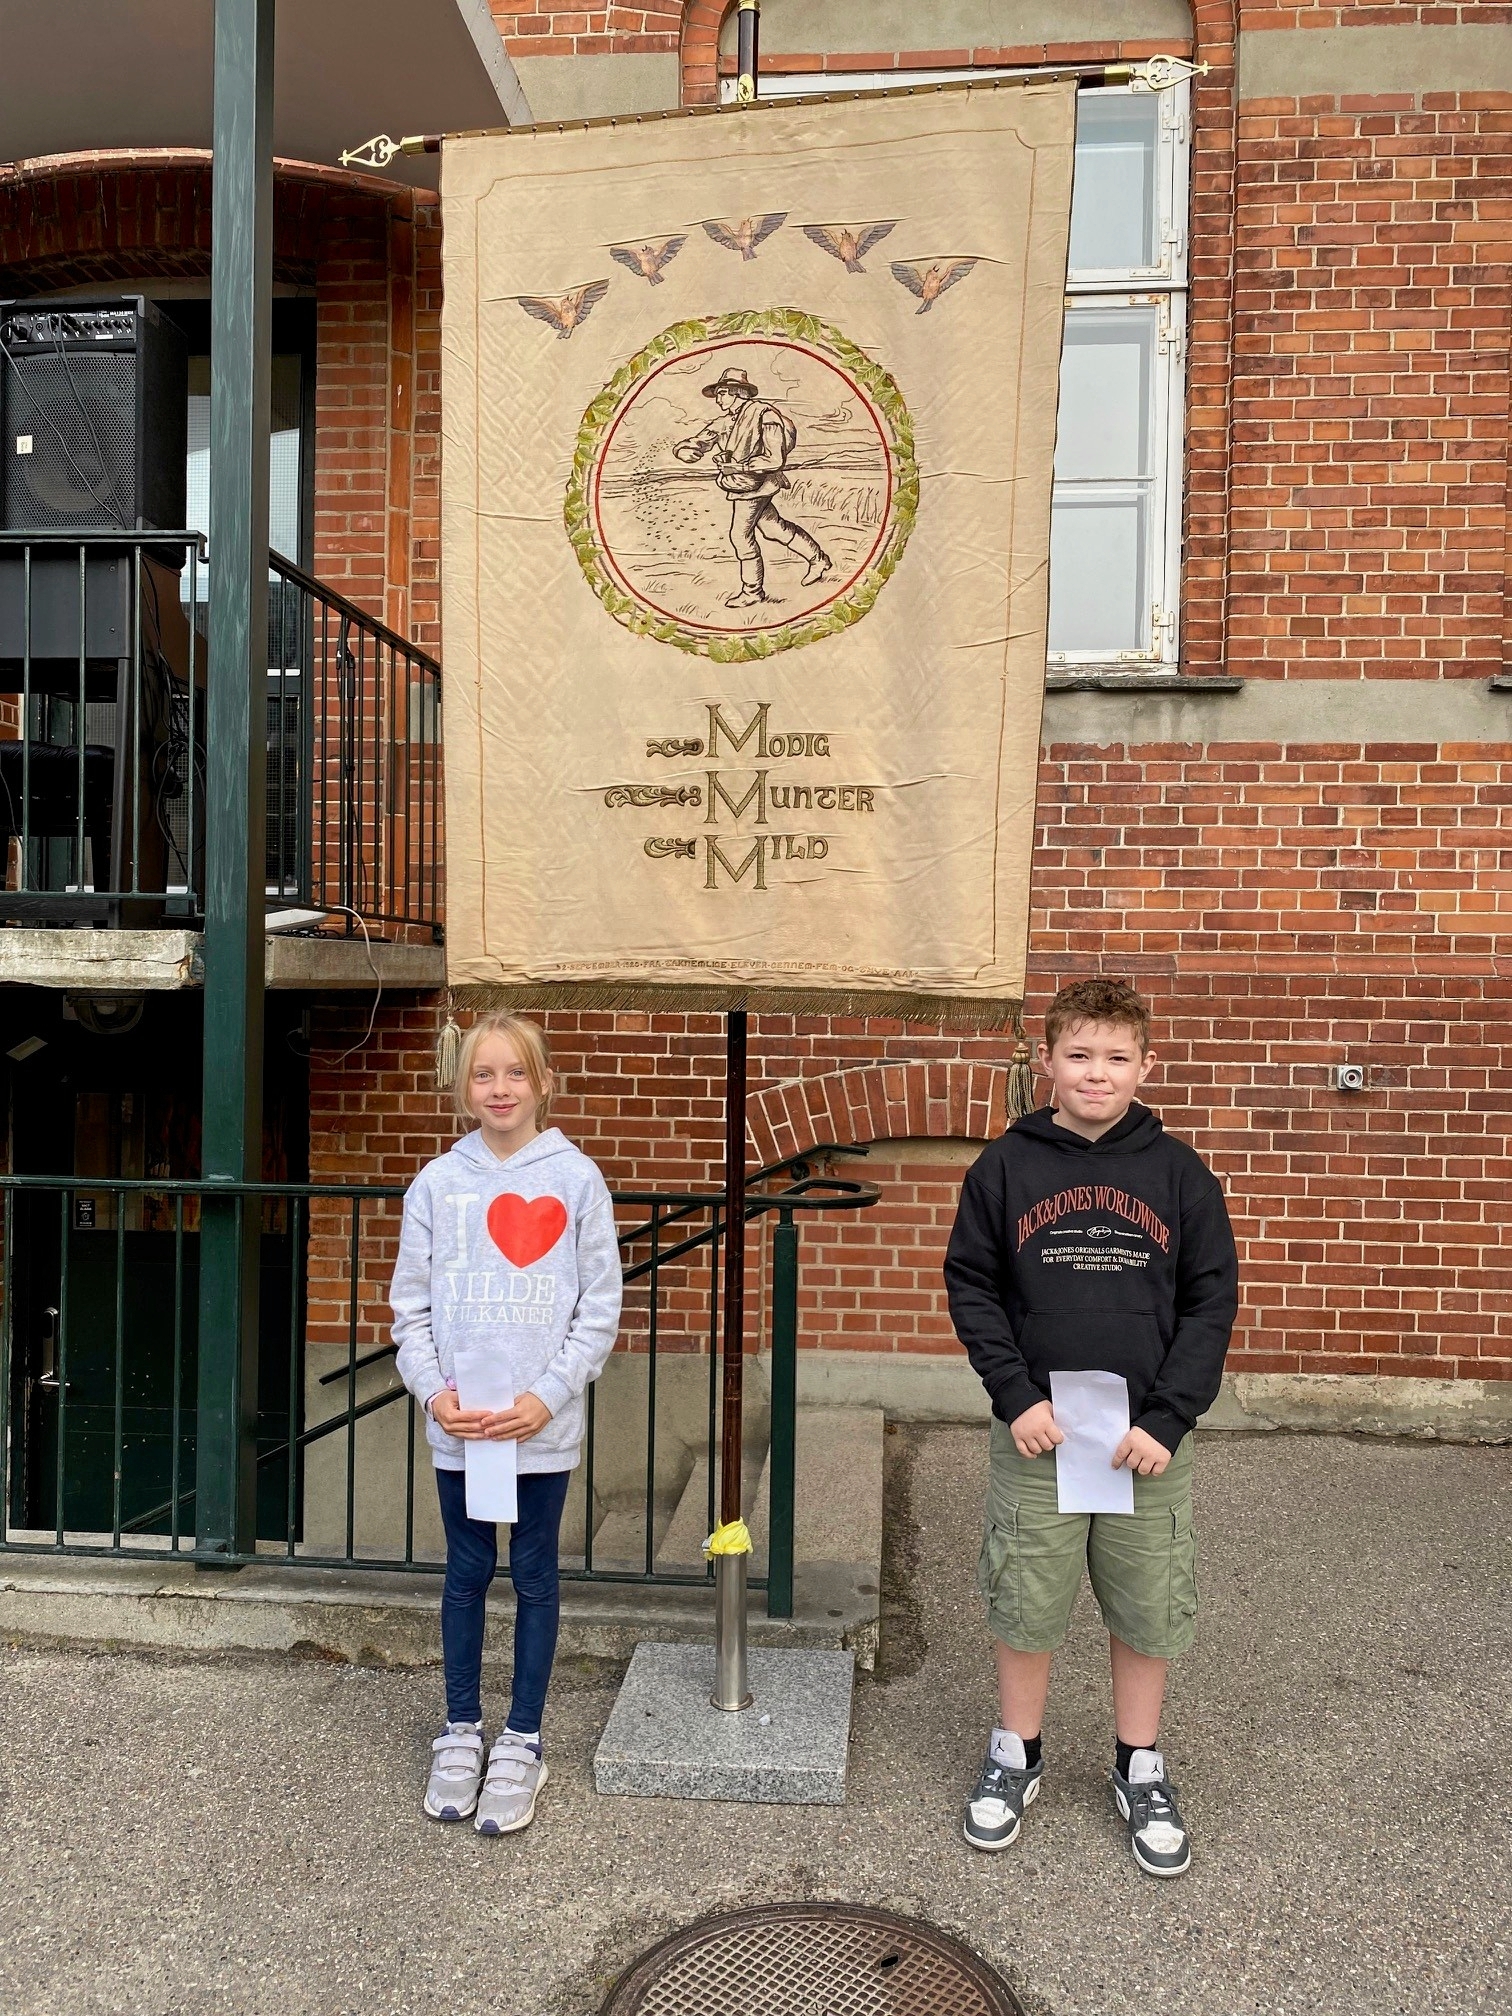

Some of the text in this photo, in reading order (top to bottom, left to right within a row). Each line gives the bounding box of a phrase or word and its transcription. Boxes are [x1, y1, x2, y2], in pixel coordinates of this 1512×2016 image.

[705, 703, 830, 757] MODIG
[703, 835, 829, 890] MILD
[445, 1193, 480, 1269] I
[1017, 1185, 1170, 1254] JACK&JONES WORLDWIDE
[1041, 1246, 1075, 1256] JACK&JONES
[1075, 1246, 1105, 1254] ORIGINALS
[1132, 1250, 1150, 1260] MADE
[1055, 1254, 1084, 1262] EVERYDAY
[1073, 1262, 1101, 1271] CREATIVE
[444, 1272, 556, 1305] VILDE
